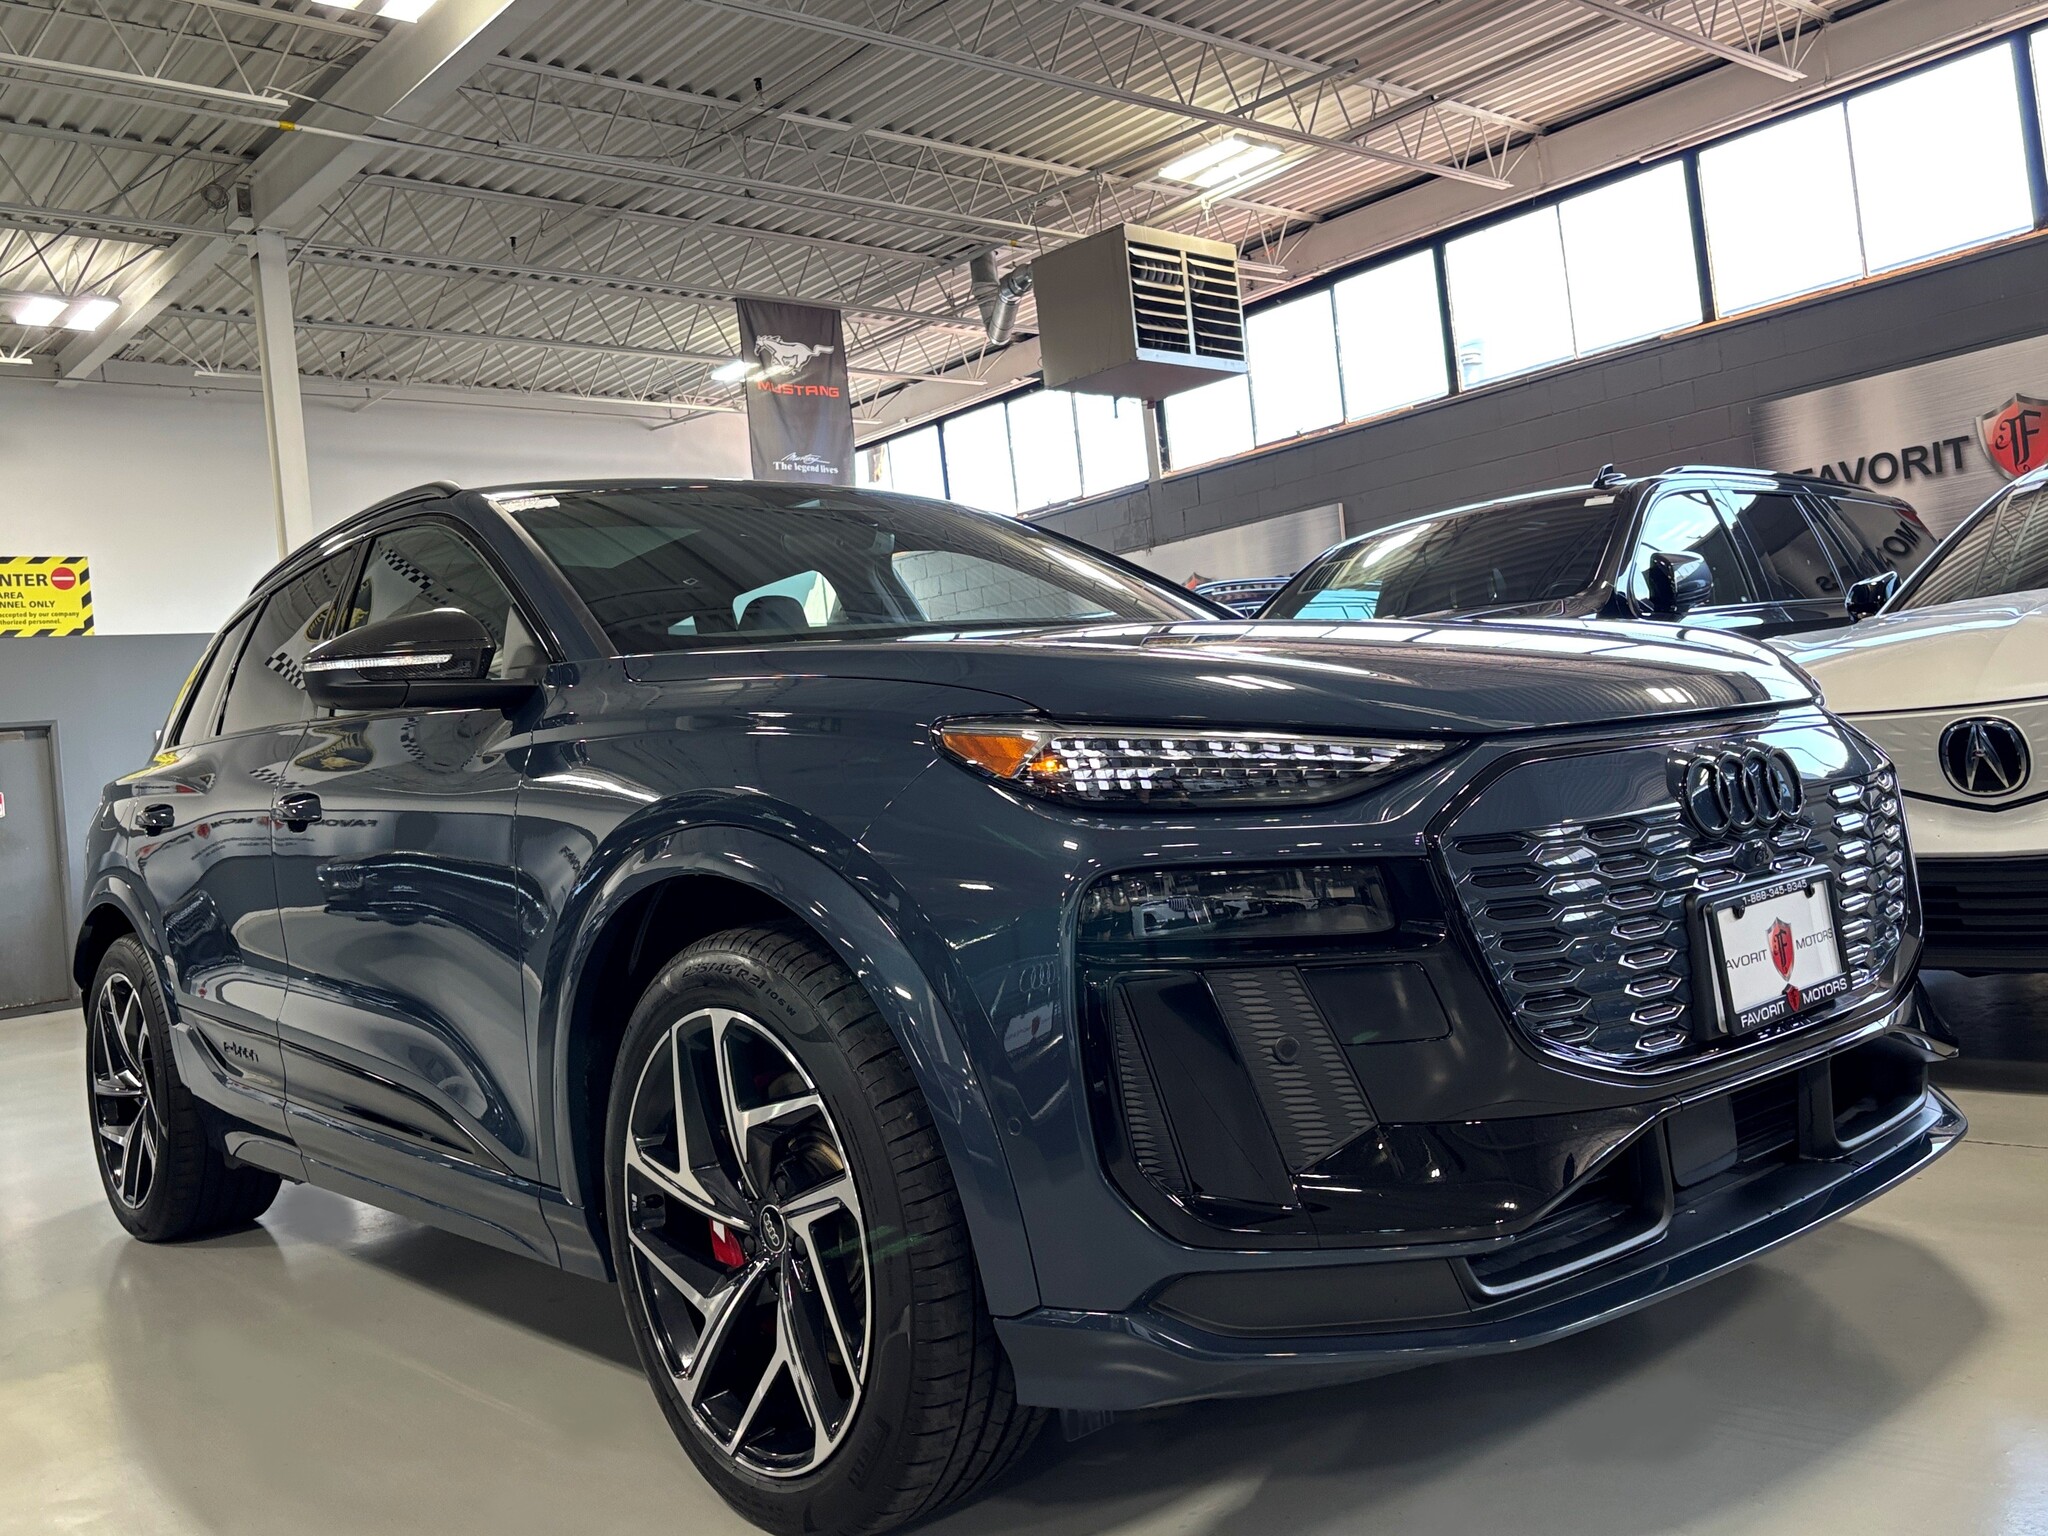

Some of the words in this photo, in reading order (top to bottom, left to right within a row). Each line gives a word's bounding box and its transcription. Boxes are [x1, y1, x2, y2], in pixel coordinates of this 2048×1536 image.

[757, 380, 840, 398] MUSTANG
[773, 461, 792, 471] The
[794, 462, 819, 473] legend
[820, 464, 839, 474] lives
[1793, 435, 1969, 486] AVORIT
[29, 600, 56, 608] ONLY
[1742, 879, 1808, 905] 1-888-345-9345
[1725, 949, 1768, 970] AVORIT
[1795, 927, 1834, 950] MOTORS
[736, 968, 767, 990] R21
[1740, 1000, 1786, 1028] FAVORIT
[1802, 978, 1848, 1005] MOTORS
